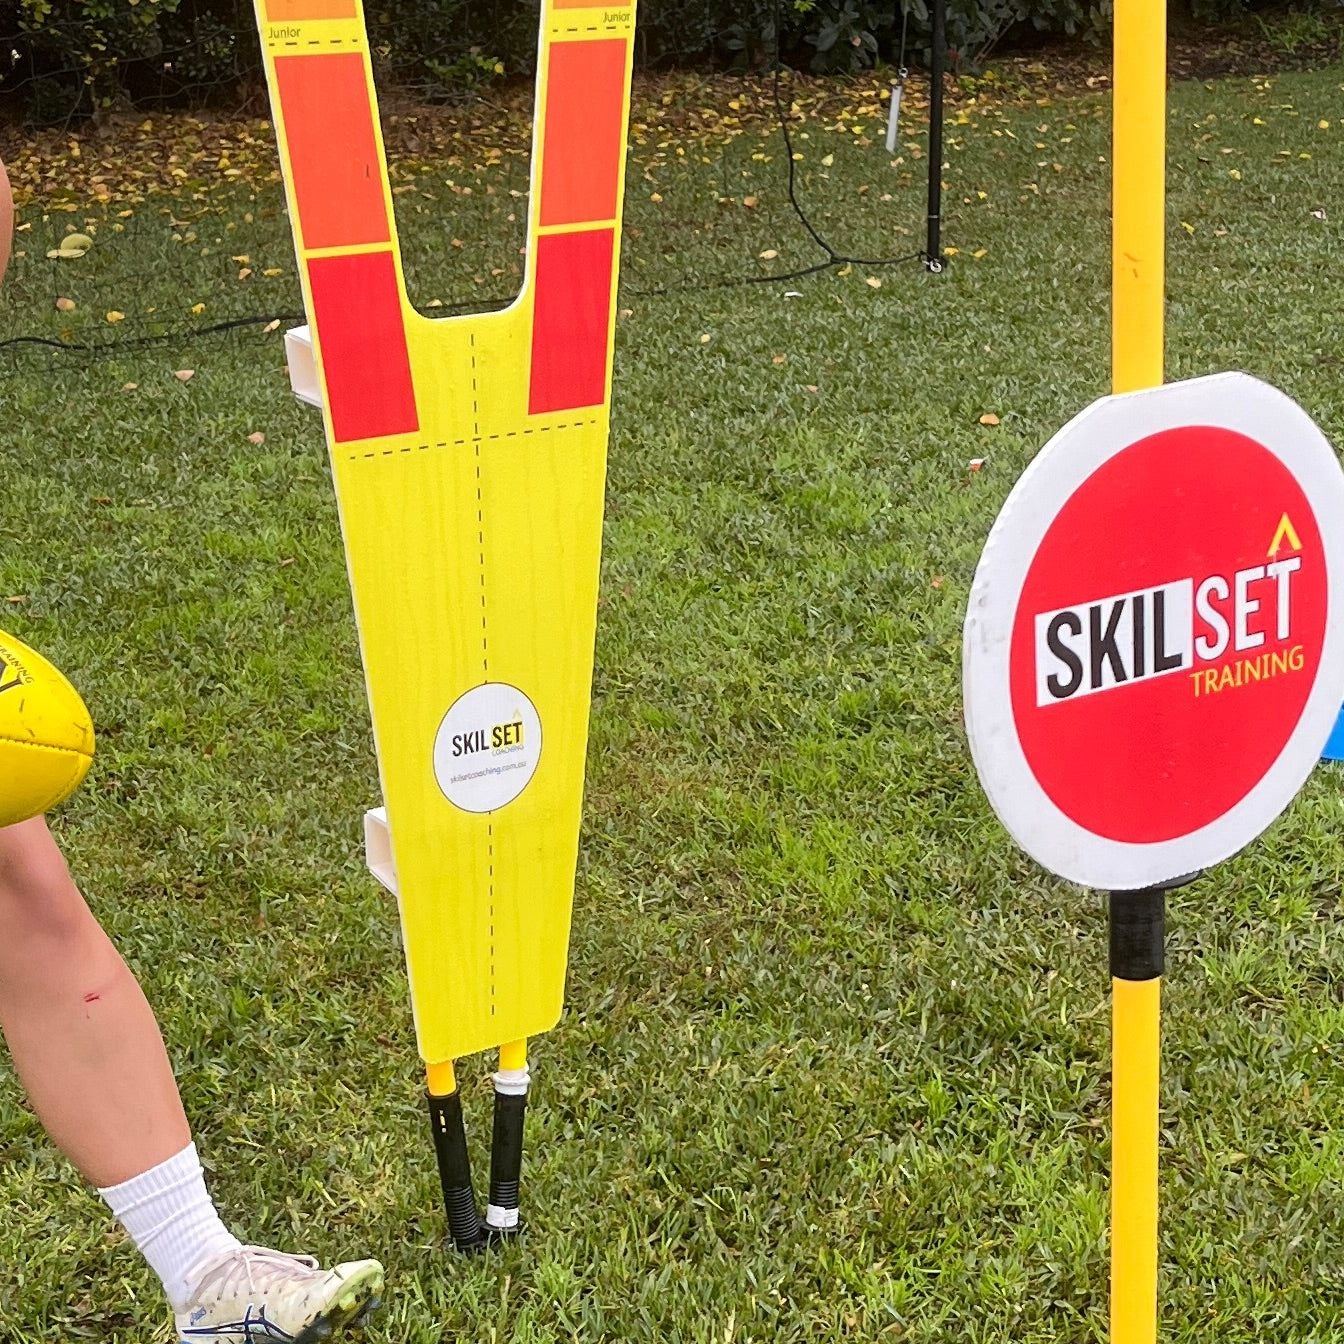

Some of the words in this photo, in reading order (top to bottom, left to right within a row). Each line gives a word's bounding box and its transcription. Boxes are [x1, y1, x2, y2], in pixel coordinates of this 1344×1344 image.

[602, 11, 631, 23] Junior
[268, 26, 301, 39] Junior
[1189, 644, 1305, 698] TRAINING
